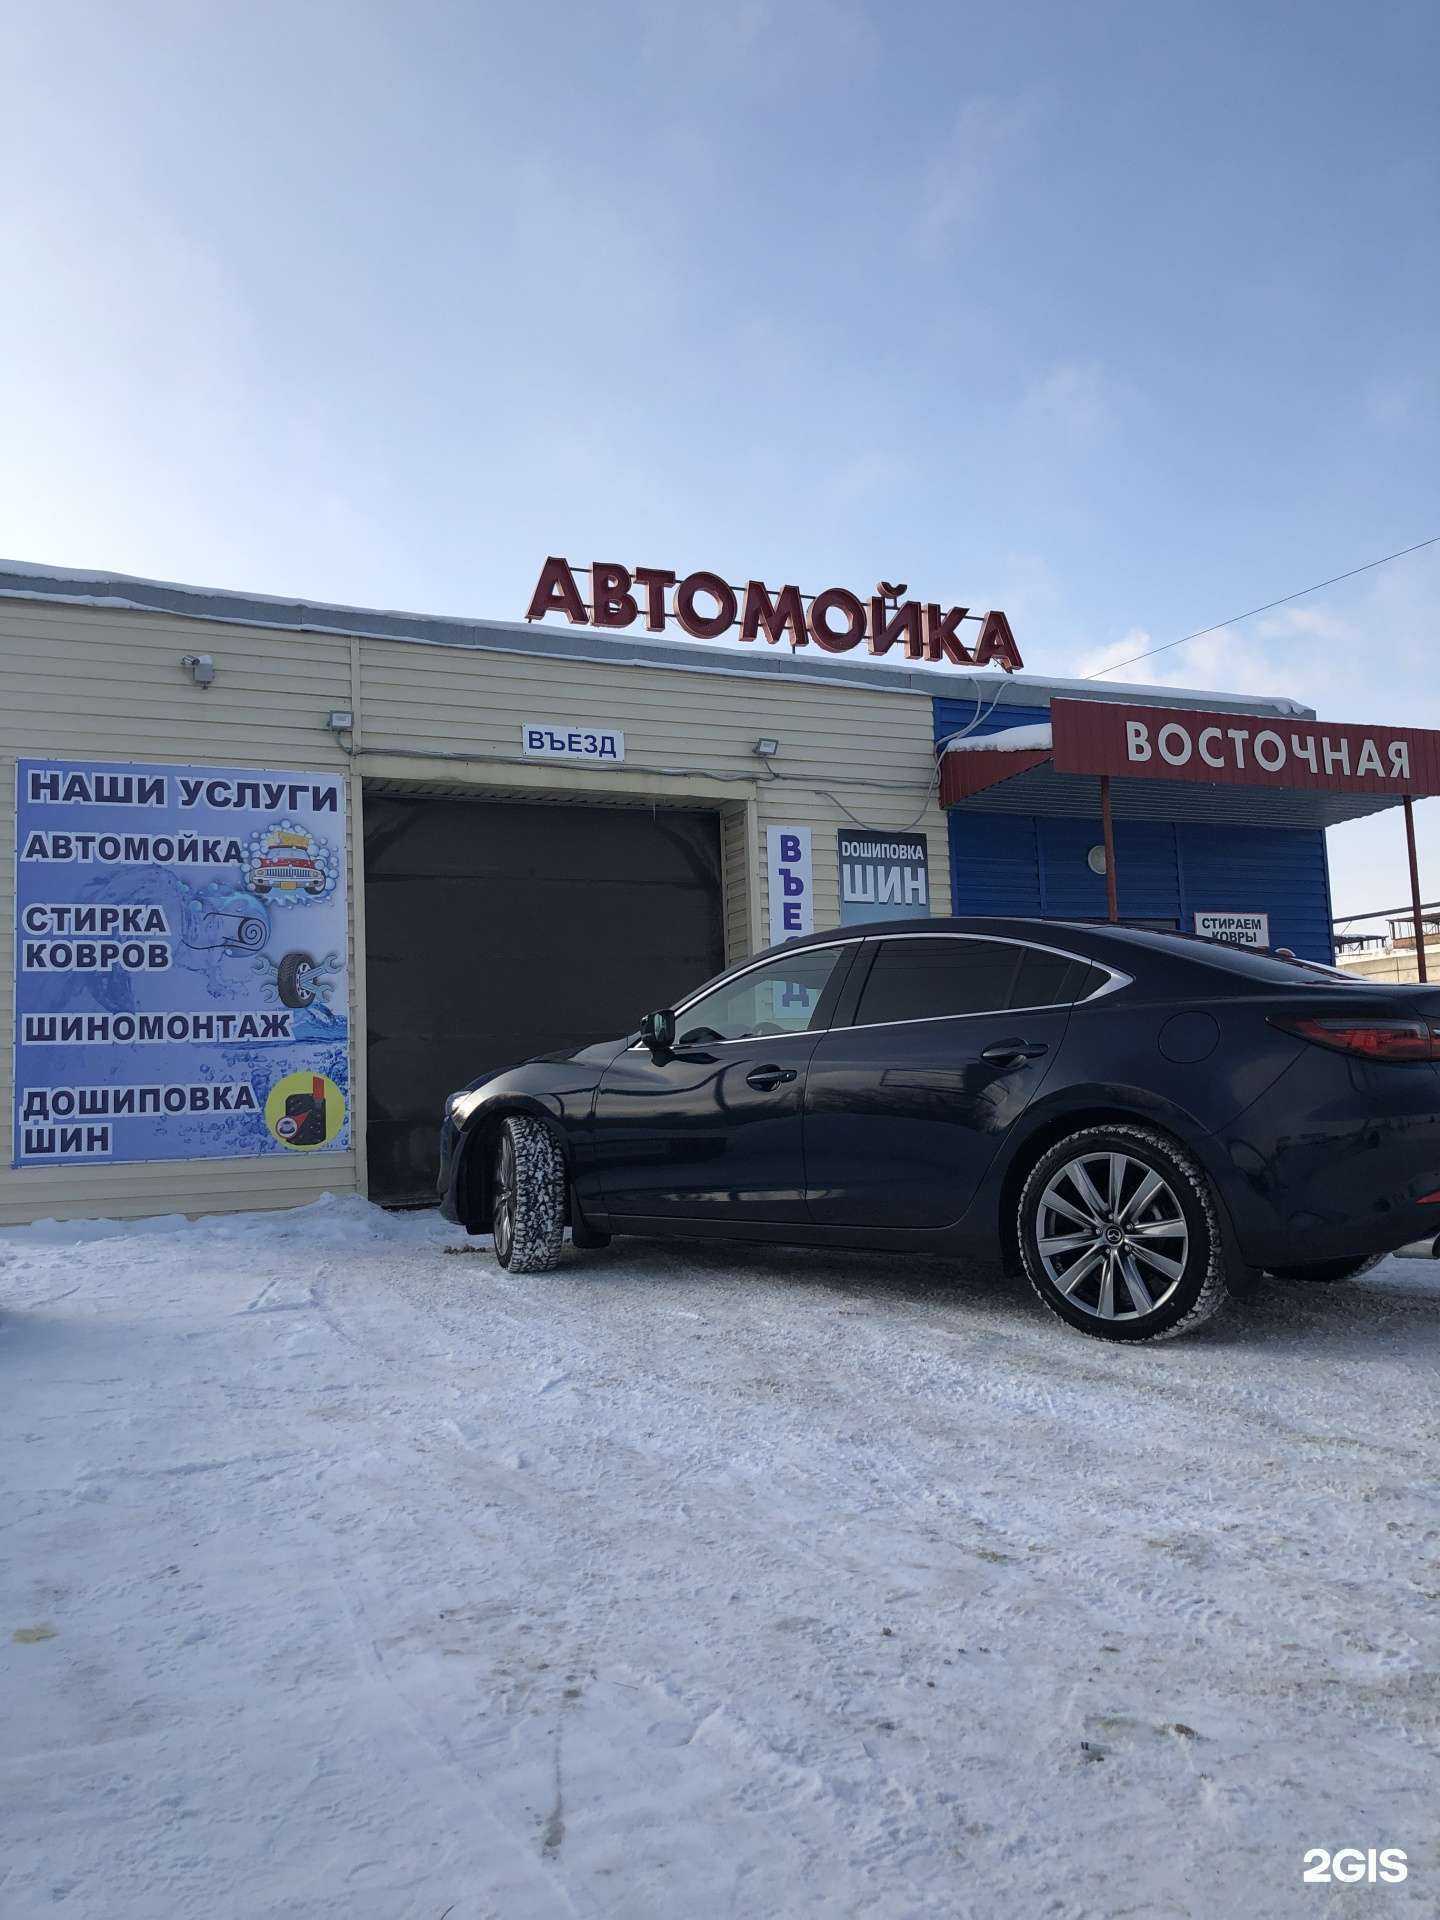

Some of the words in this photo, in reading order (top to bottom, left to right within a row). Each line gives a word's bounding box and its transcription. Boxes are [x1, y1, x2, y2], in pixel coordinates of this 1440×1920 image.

[526, 556, 1025, 671] АВТОМОЙКА
[527, 730, 617, 759] ВЪЕЗД
[1125, 720, 1411, 779] ВОСТОЧНАЯ
[30, 773, 165, 805] НАШИ
[179, 779, 338, 812] УСЛУГИ
[25, 833, 243, 864] АВТОМОЙКА
[842, 863, 927, 905] ШИН
[26, 907, 167, 933] СТИРКА
[1201, 917, 1262, 930] СТИРАЕМ
[26, 943, 169, 969] КОВРОВ
[25, 1014, 291, 1042] ШИНОМОНТАЖ
[23, 1085, 256, 1122] ДОШИПОВКА
[24, 1127, 109, 1154] ШИН
